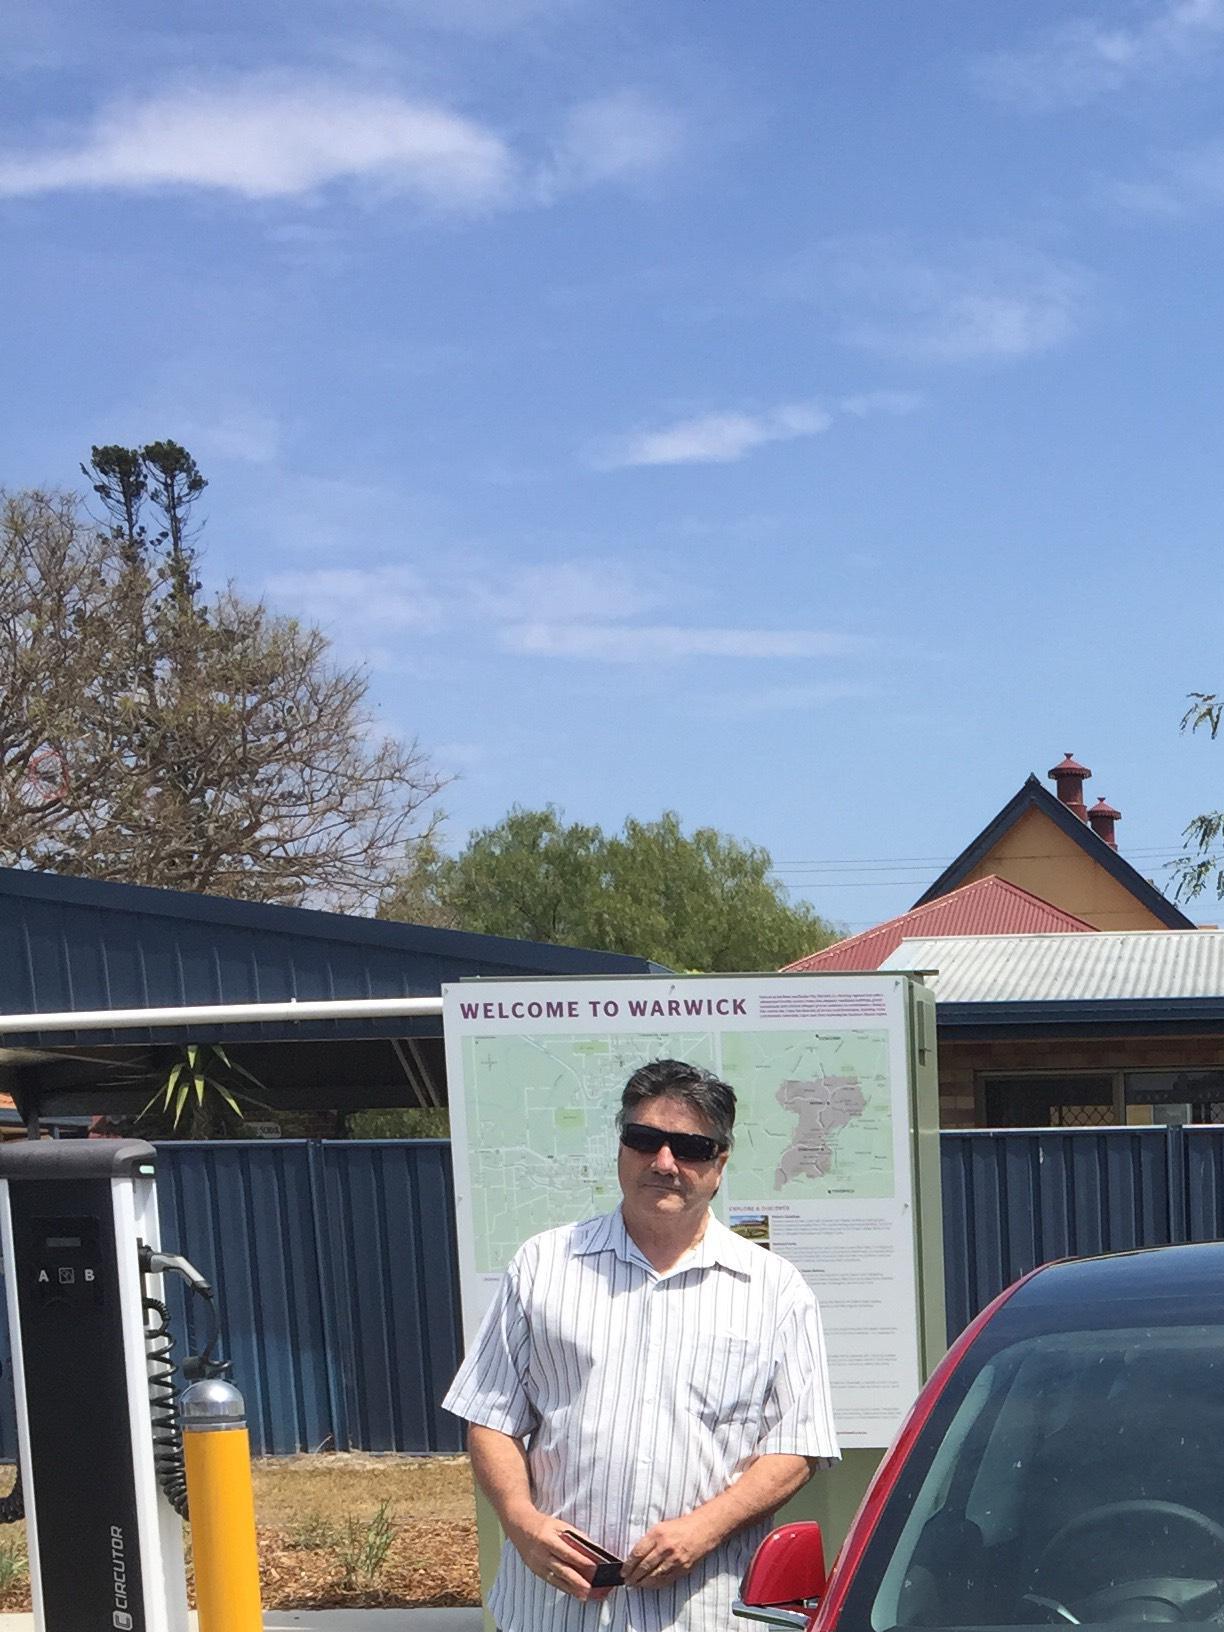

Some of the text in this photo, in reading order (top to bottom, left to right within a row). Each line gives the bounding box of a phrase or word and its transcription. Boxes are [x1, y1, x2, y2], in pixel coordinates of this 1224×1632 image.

[460, 1001, 579, 1020] WELCOME
[589, 1000, 619, 1018] TO
[628, 998, 747, 1018] WARWICK
[38, 1268, 95, 1282] A B
[110, 1525, 128, 1609] CIRCUTOR
